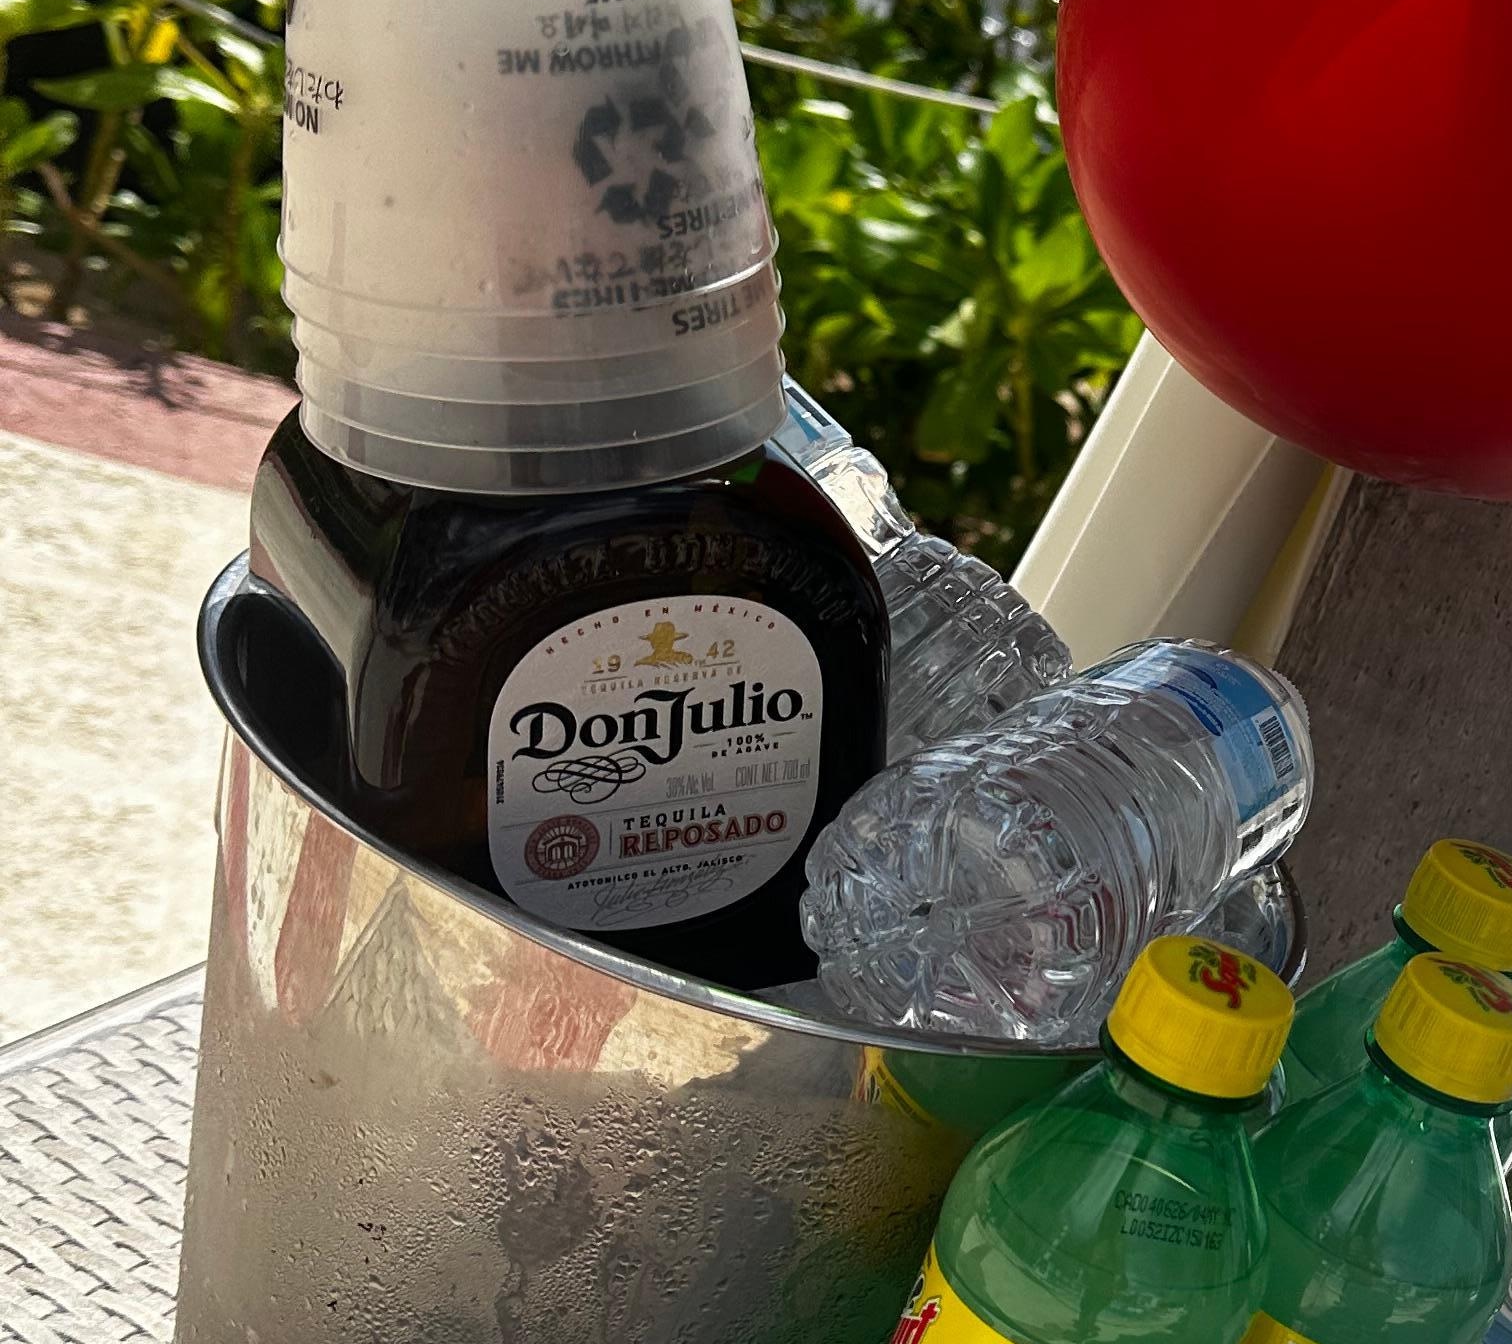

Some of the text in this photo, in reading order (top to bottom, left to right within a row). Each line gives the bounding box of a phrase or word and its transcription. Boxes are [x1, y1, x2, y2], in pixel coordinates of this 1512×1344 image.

[496, 49, 541, 75] ME
[295, 100, 319, 135] NO
[671, 292, 742, 336] TIRES
[545, 603, 776, 655] HECHO EN MÉXICO
[591, 638, 736, 674] 19 42
[711, 741, 780, 759] DE AGAVE
[726, 732, 766, 748] 100%
[623, 803, 727, 831] TEQUILA
[619, 809, 788, 858] REPOSADO
[643, 869, 658, 879] EL
[696, 854, 744, 870] JALISCO
